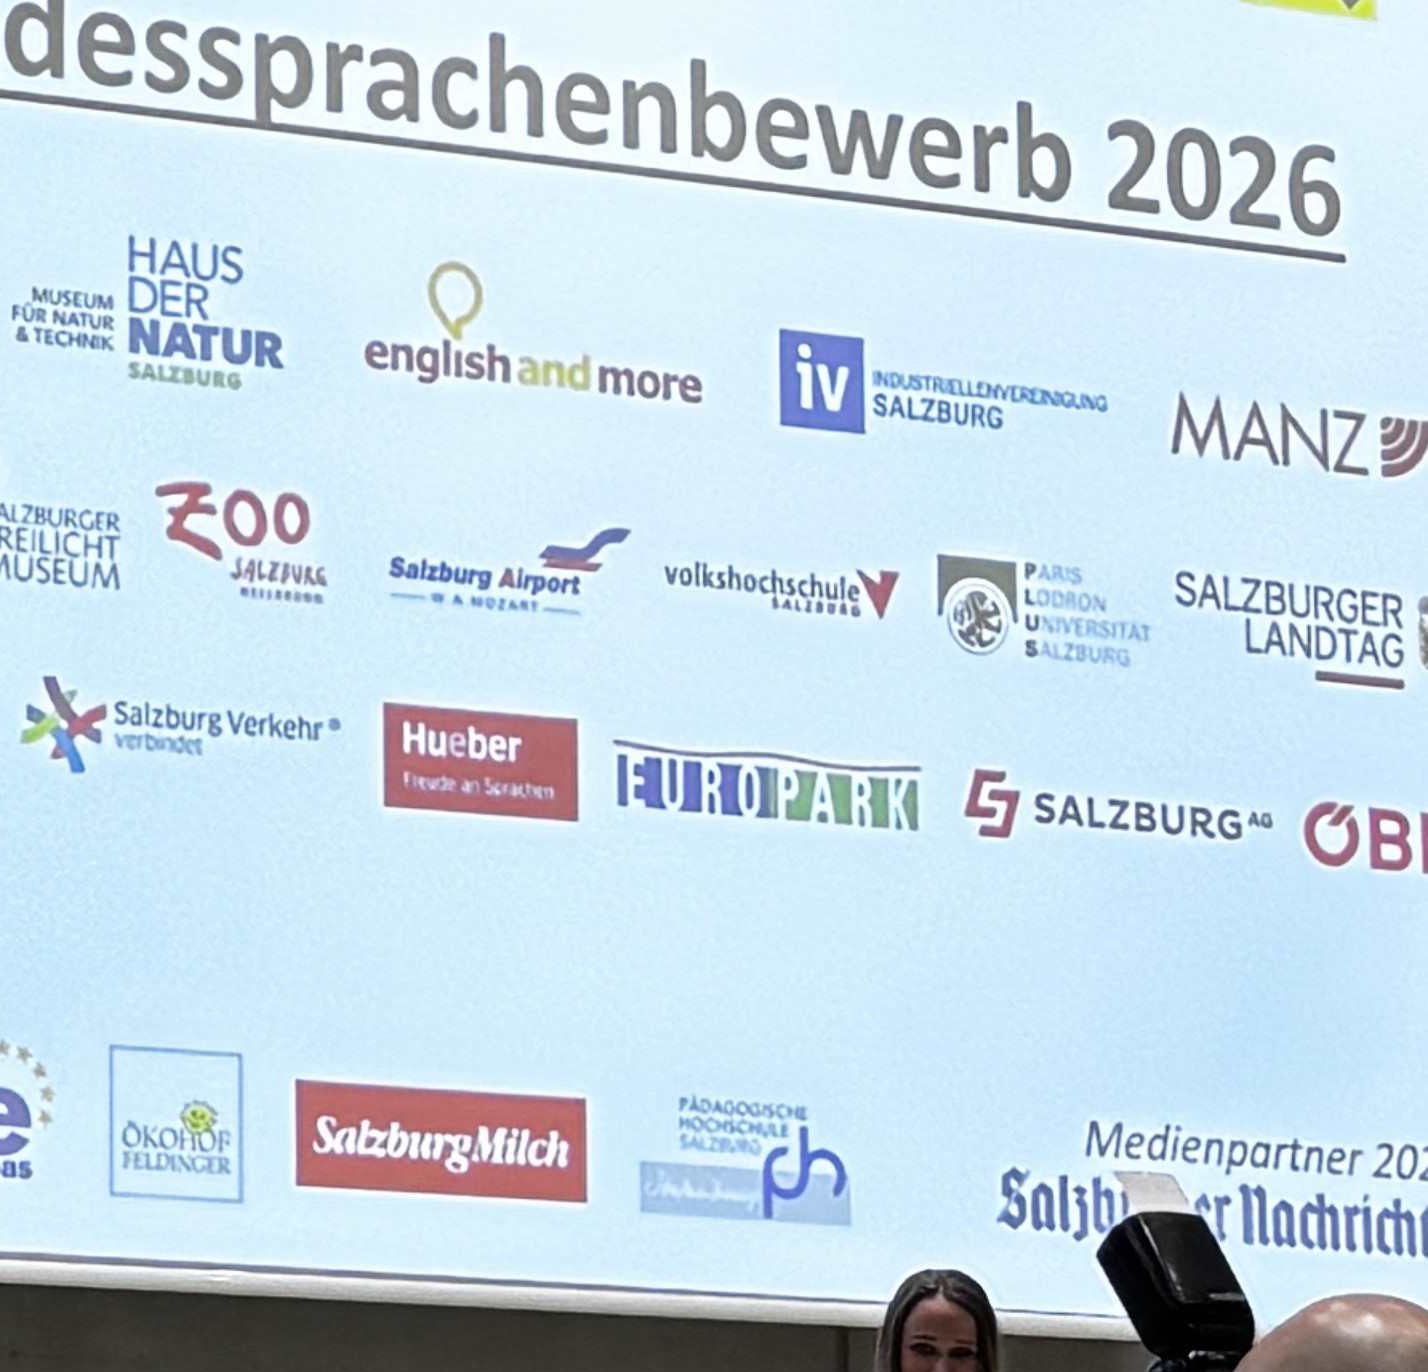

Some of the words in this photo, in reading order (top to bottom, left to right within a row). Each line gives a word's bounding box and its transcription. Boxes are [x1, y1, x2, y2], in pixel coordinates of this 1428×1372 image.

[1105, 118, 1340, 237] 2026
[128, 234, 244, 285] HAUS
[11, 303, 46, 324] FÜR
[52, 310, 114, 331] NATUR
[31, 286, 114, 310] MUSEUM
[127, 275, 209, 321] DER
[15, 326, 29, 342] &
[33, 328, 114, 351] TECHNIK
[128, 317, 284, 369] NATUR
[128, 361, 243, 391] SALZBURG
[364, 339, 511, 384] english
[517, 354, 592, 391] and
[598, 365, 703, 404] more
[795, 343, 850, 412] iv
[873, 394, 1004, 430] SALZBURG
[1171, 390, 1370, 477] MANZ
[230, 556, 328, 587] SALZBURG
[389, 556, 492, 590] Salzburg
[498, 567, 581, 595] Airport
[664, 561, 861, 602] volkshochschule
[1024, 562, 1082, 585] PARIS
[1024, 588, 1107, 612] LODRON
[1175, 571, 1404, 629] SALZBURGER
[1025, 639, 1131, 668] SALZBURG
[1245, 619, 1405, 668] LANDTAG
[114, 701, 224, 738] Salzburg
[227, 710, 324, 742] Verkehr
[401, 720, 523, 763] Hueber
[114, 734, 204, 756] verbindet
[461, 780, 480, 796] an
[625, 755, 913, 832] EUROPARK
[1034, 793, 1243, 841] SALZBURG
[1304, 801, 1428, 874] ÖB
[122, 1120, 231, 1153] ÖKOHOF
[312, 1116, 569, 1173] SalzburgMilch
[1085, 1120, 1363, 1176] Medienpartner
[122, 1150, 231, 1175] FELDINGER
